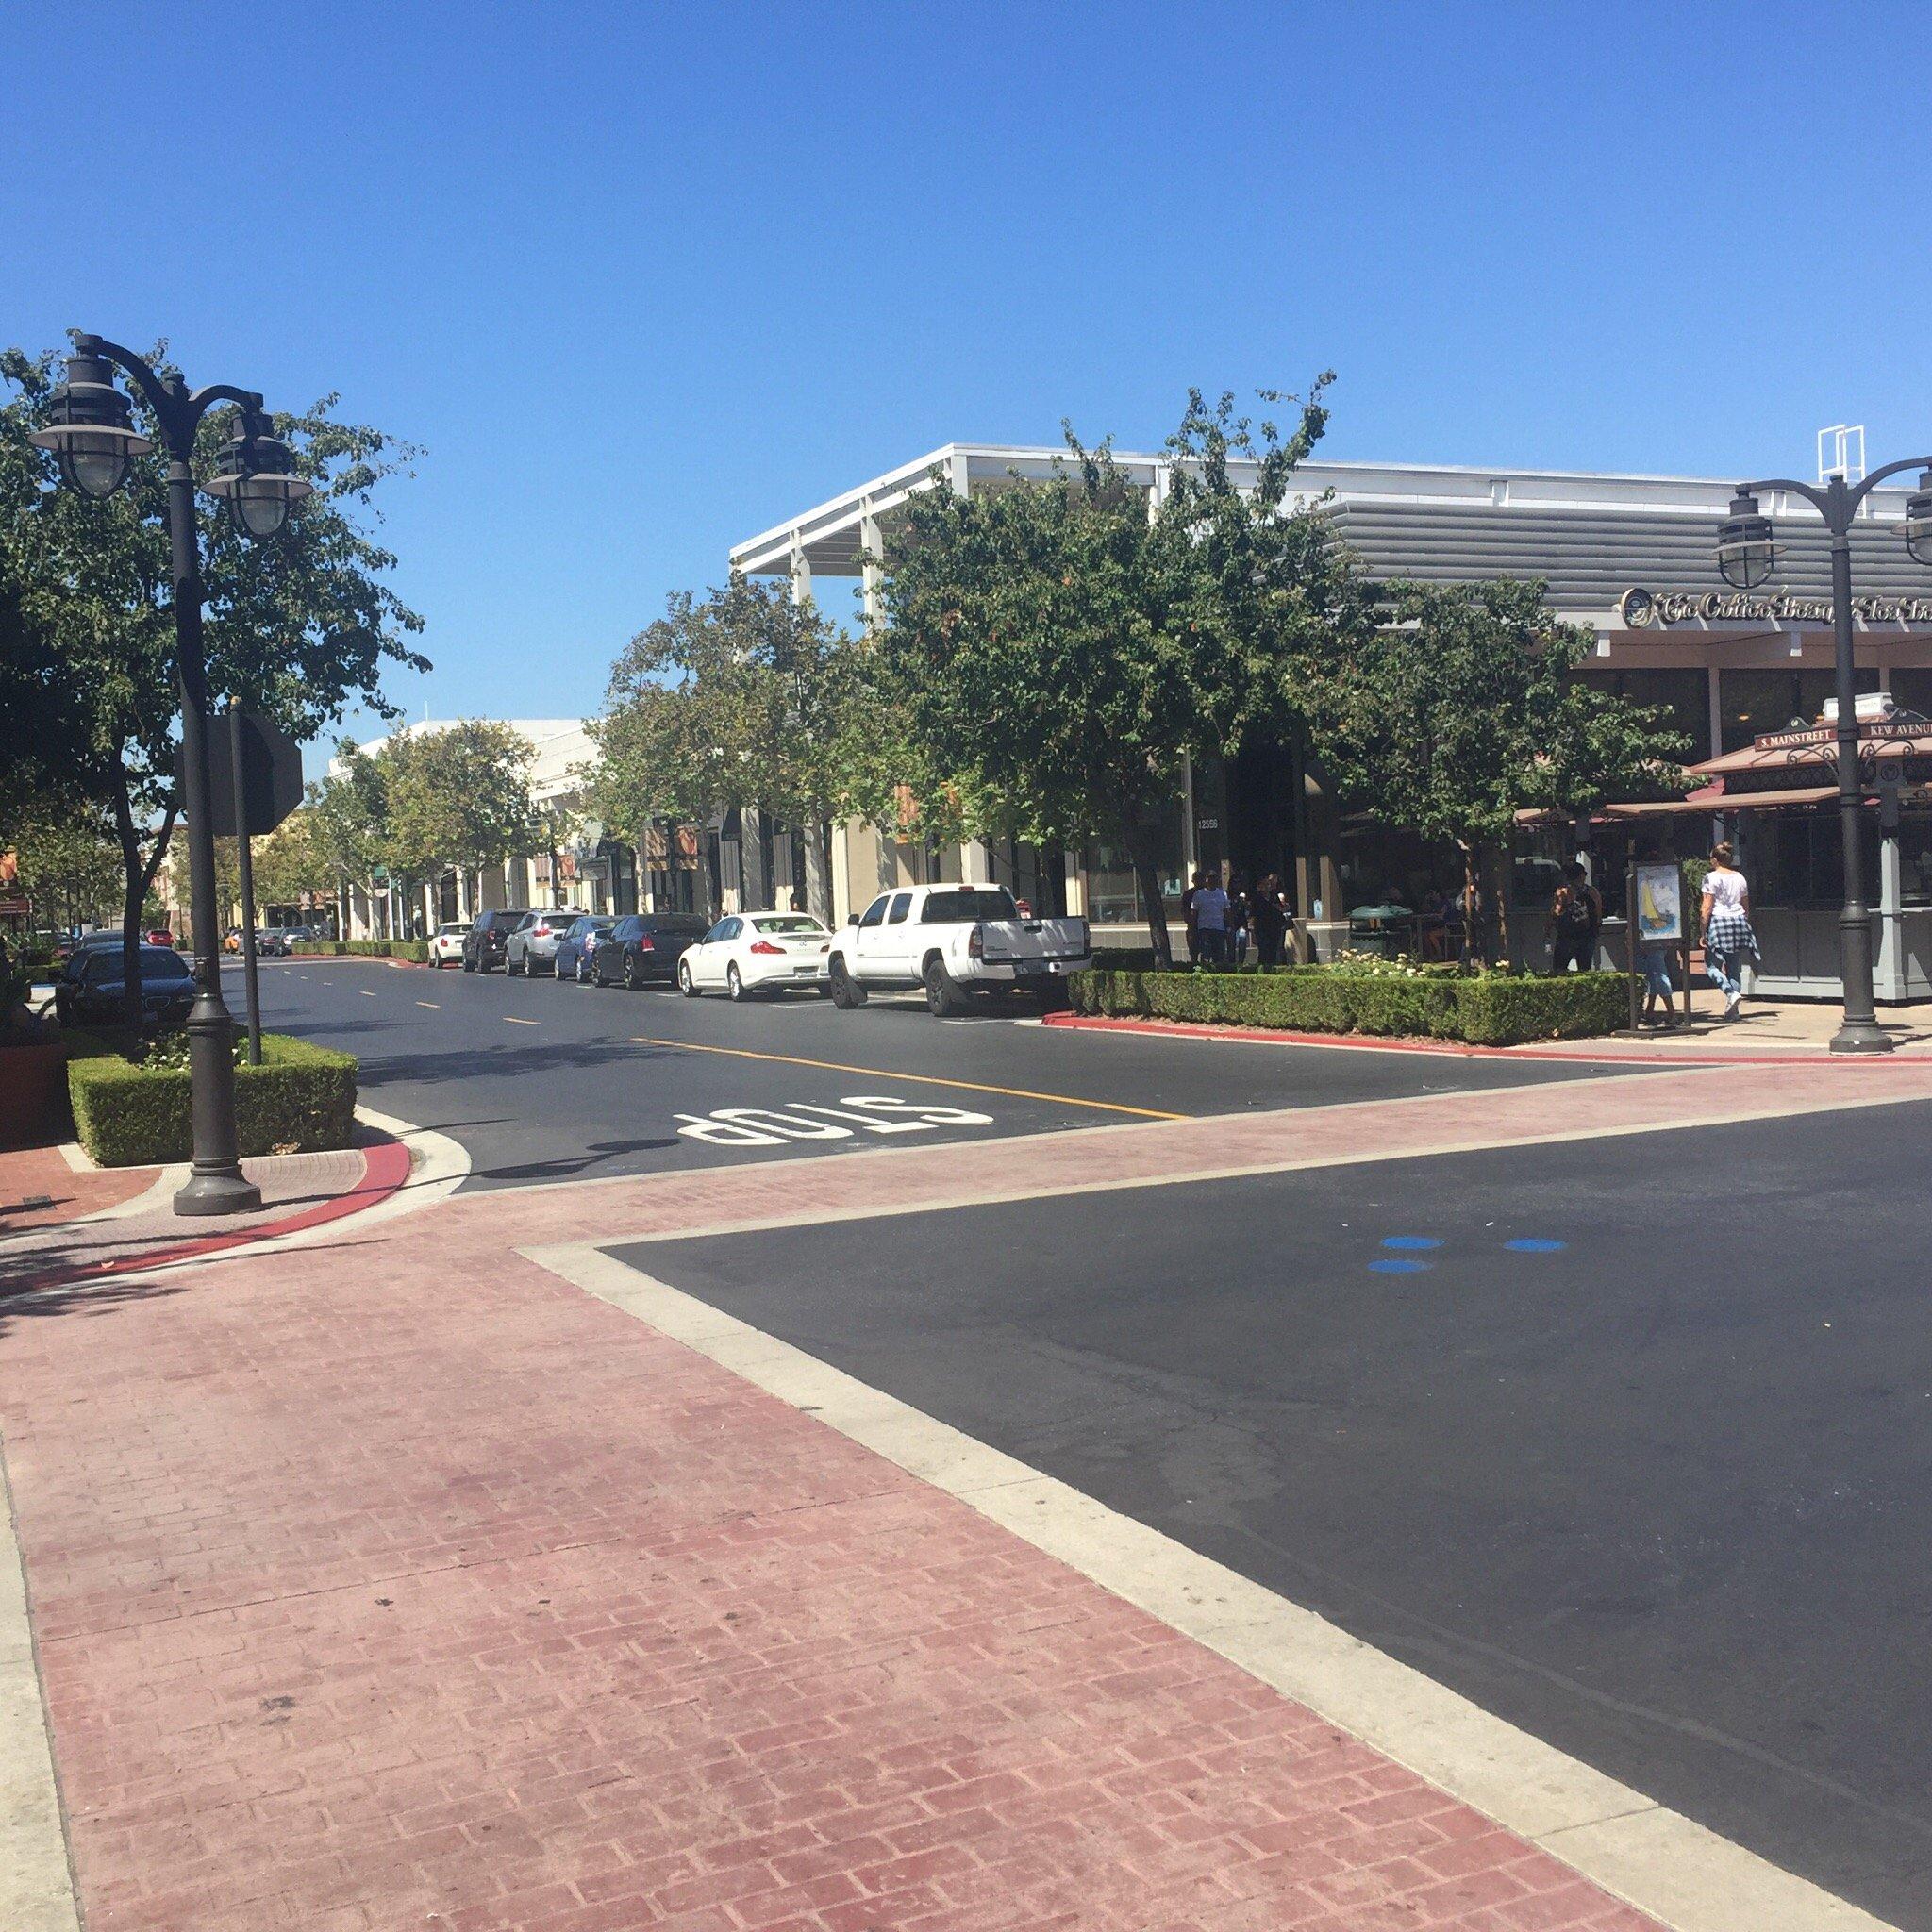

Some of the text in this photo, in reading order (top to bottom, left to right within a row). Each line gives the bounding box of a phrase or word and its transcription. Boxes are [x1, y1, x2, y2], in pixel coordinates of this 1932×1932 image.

[1700, 592, 1771, 620] Coffee
[1771, 729, 1831, 746] MAINSTREET
[1871, 725, 1893, 736] KEW
[673, 1096, 994, 1146] STOP
